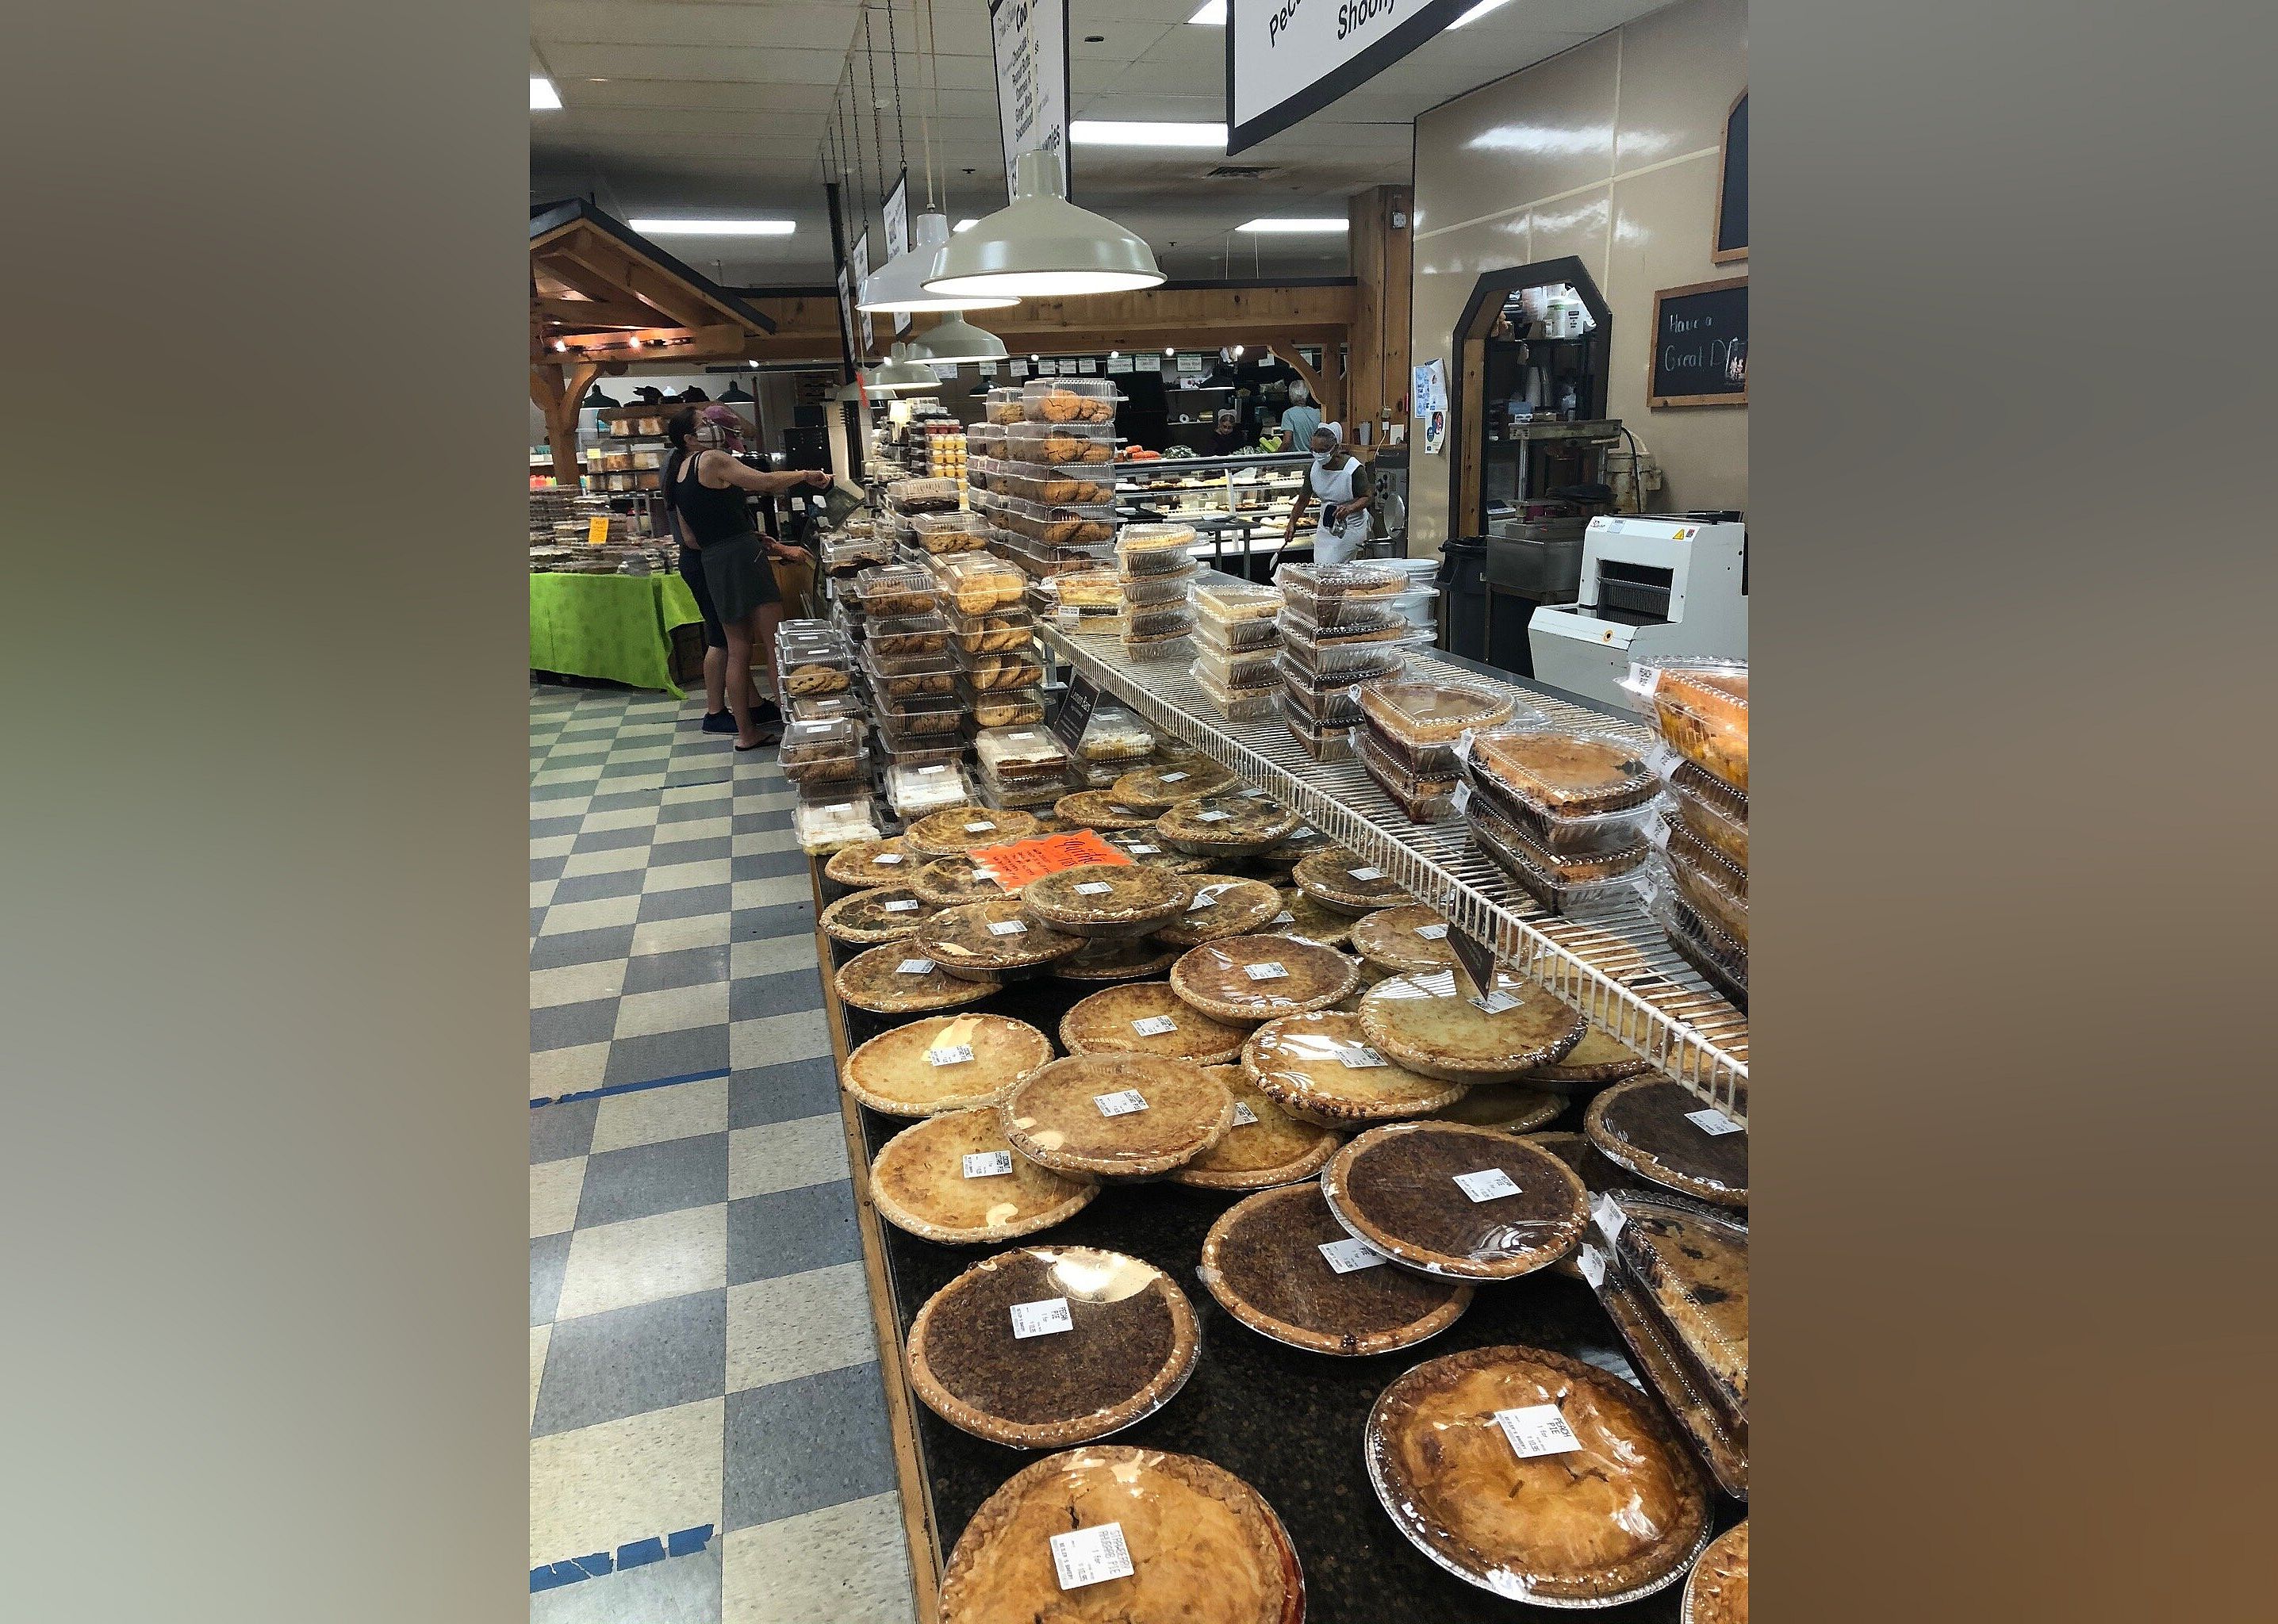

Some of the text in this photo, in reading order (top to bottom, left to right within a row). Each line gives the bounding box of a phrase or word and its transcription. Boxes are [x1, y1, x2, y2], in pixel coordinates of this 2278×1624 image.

[1269, 0, 1301, 48] Pec
[1670, 314, 1713, 333] Have a
[1547, 1422, 1561, 1435] PIE
